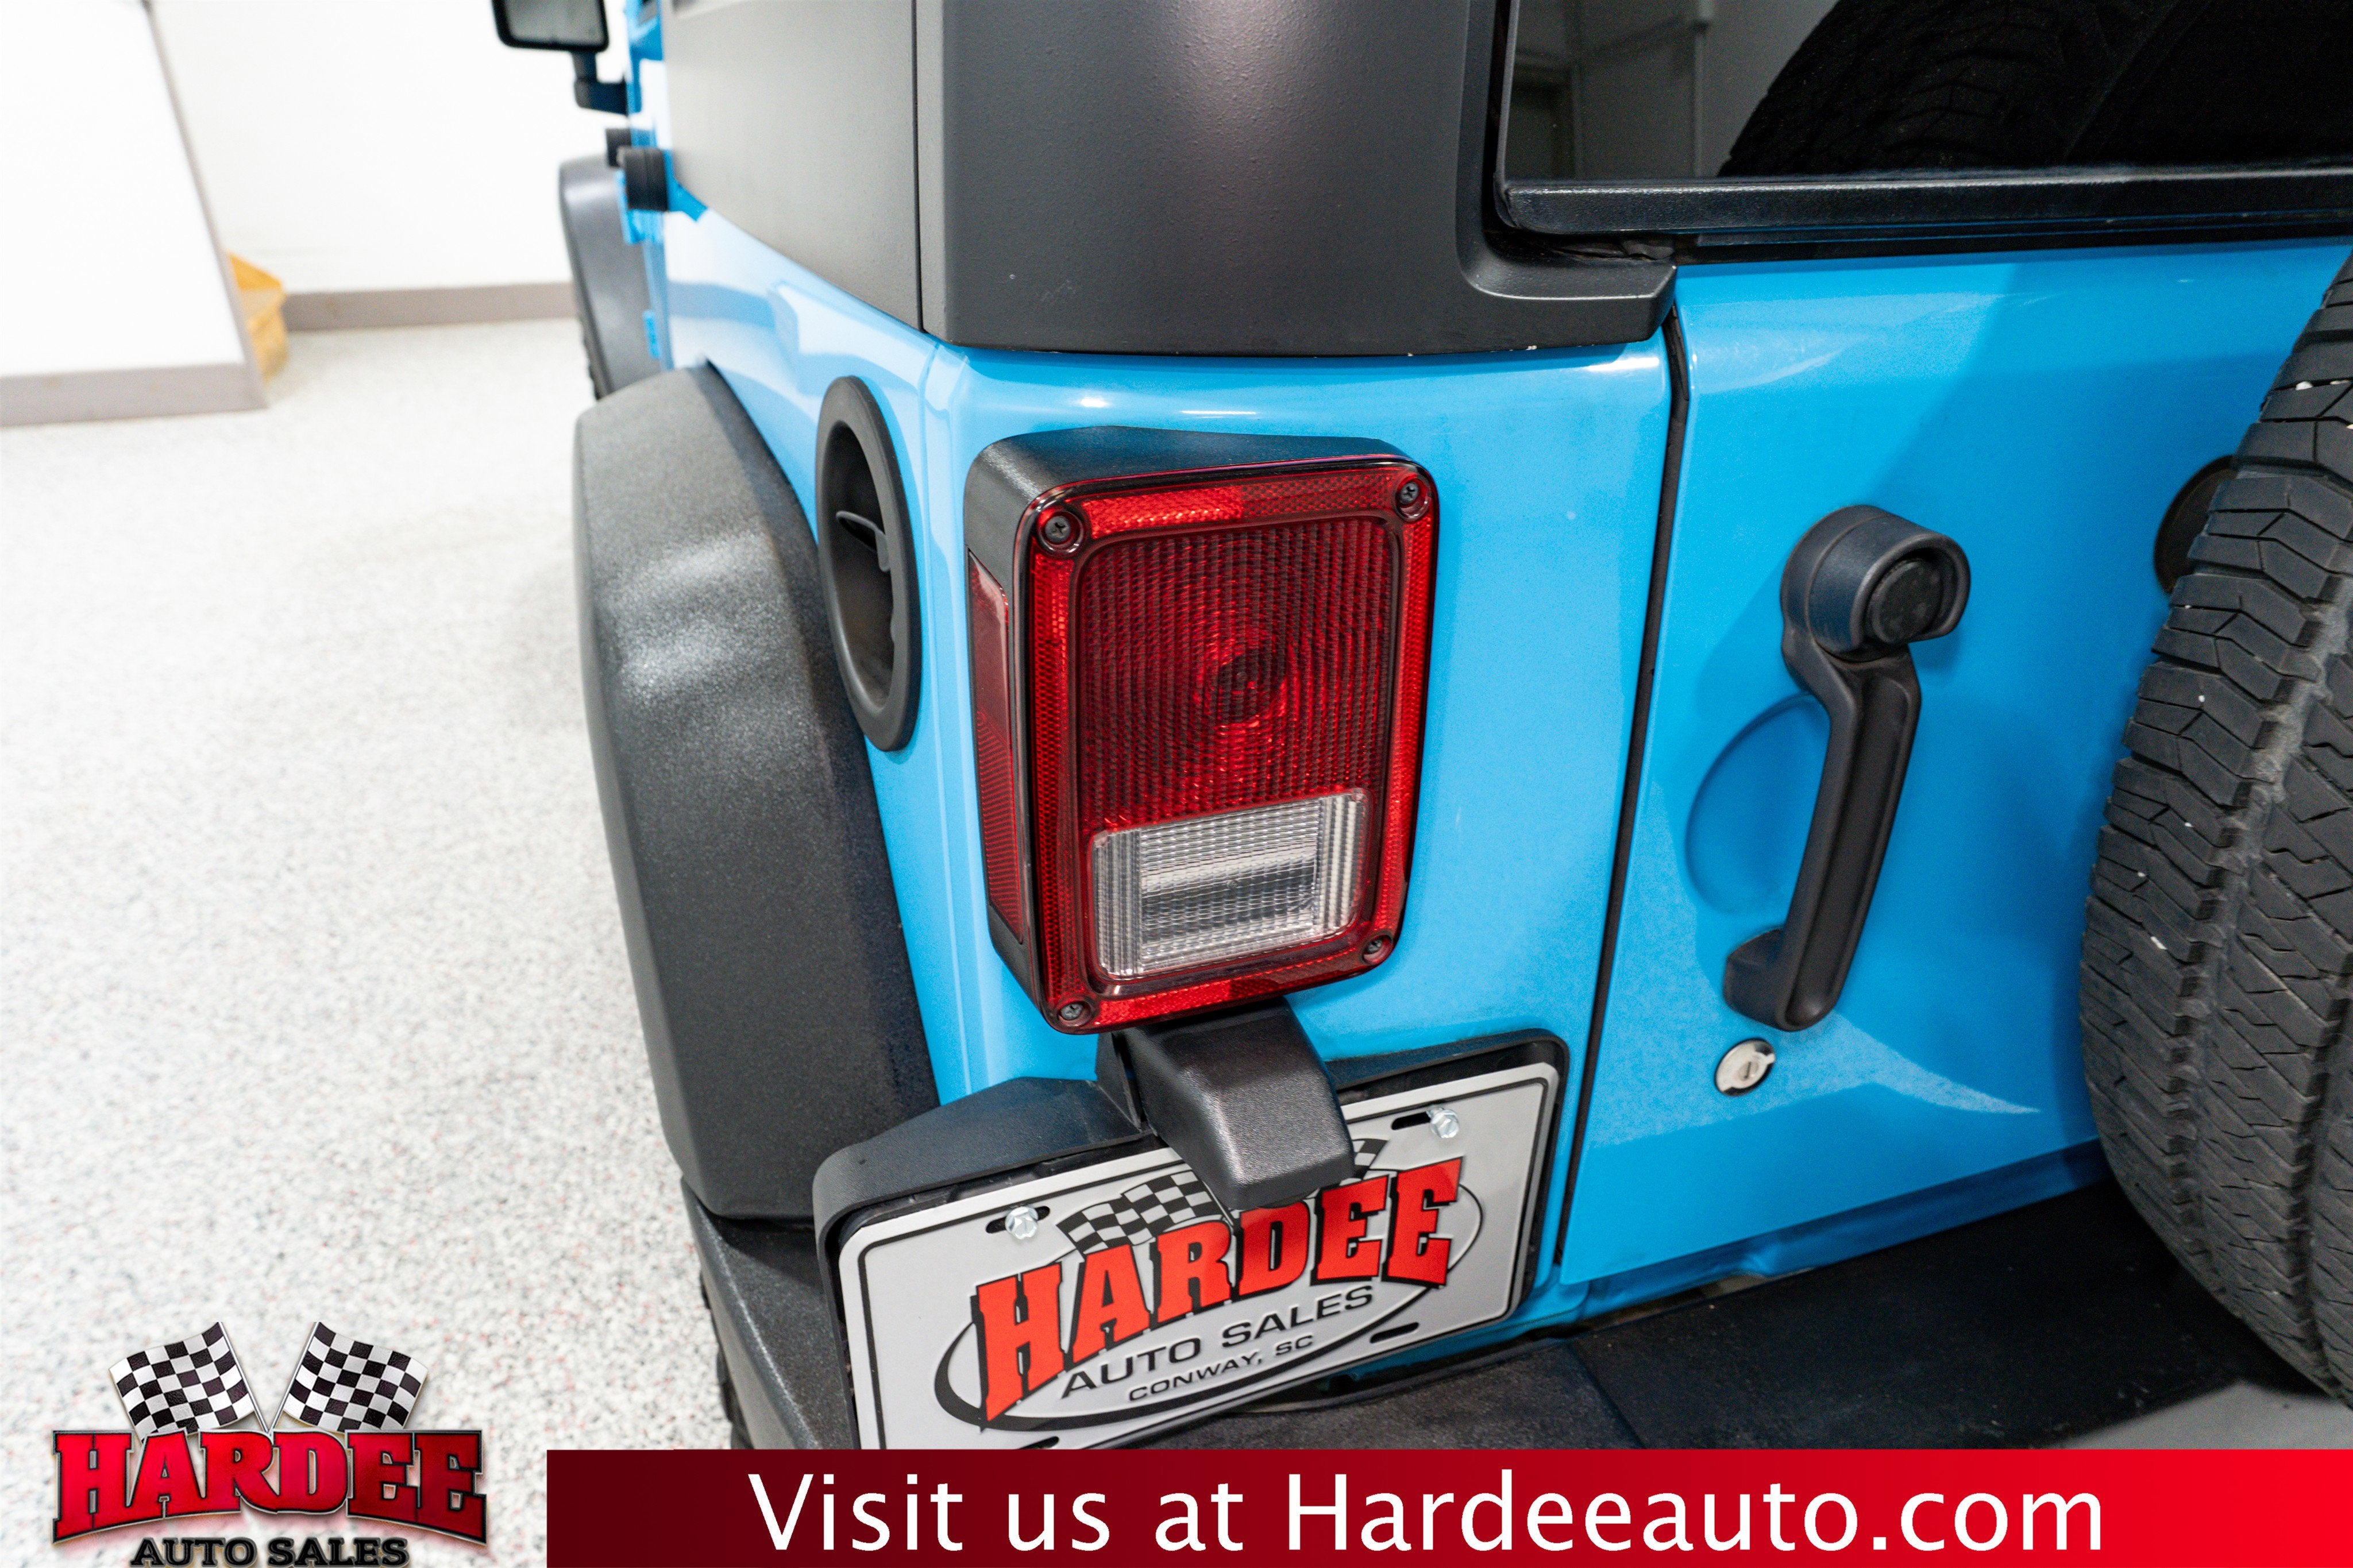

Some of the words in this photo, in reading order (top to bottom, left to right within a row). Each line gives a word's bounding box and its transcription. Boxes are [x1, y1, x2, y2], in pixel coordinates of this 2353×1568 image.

[971, 1156, 1463, 1426] HARDEE
[1061, 1337, 1202, 1399] AUTO
[1222, 1285, 1373, 1348] SALES
[1128, 1351, 1263, 1402] CONWAY,
[1276, 1335, 1314, 1357] SC
